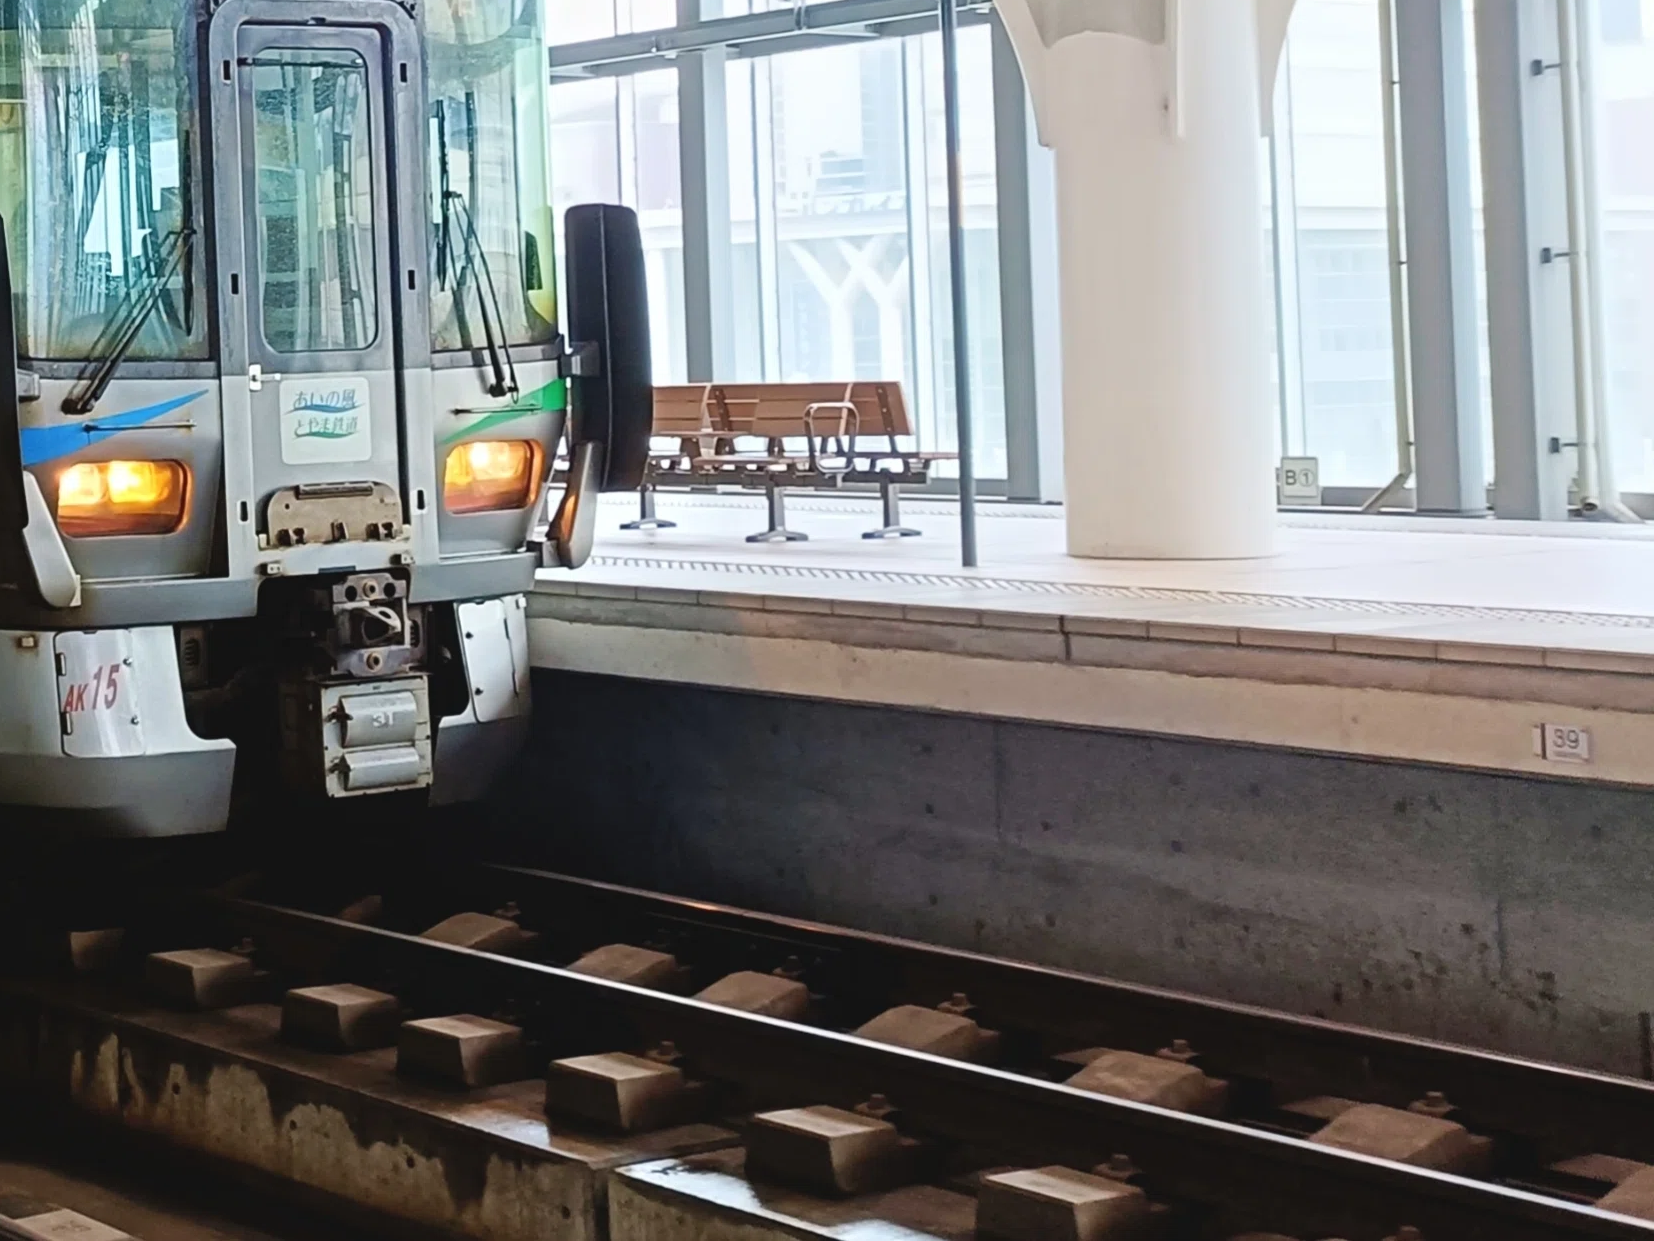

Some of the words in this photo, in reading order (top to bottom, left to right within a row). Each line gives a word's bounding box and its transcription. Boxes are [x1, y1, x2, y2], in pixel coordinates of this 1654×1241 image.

[293, 388, 357, 409] あいの風
[294, 416, 359, 437] とやま鉄道
[1552, 728, 1581, 749] 39
